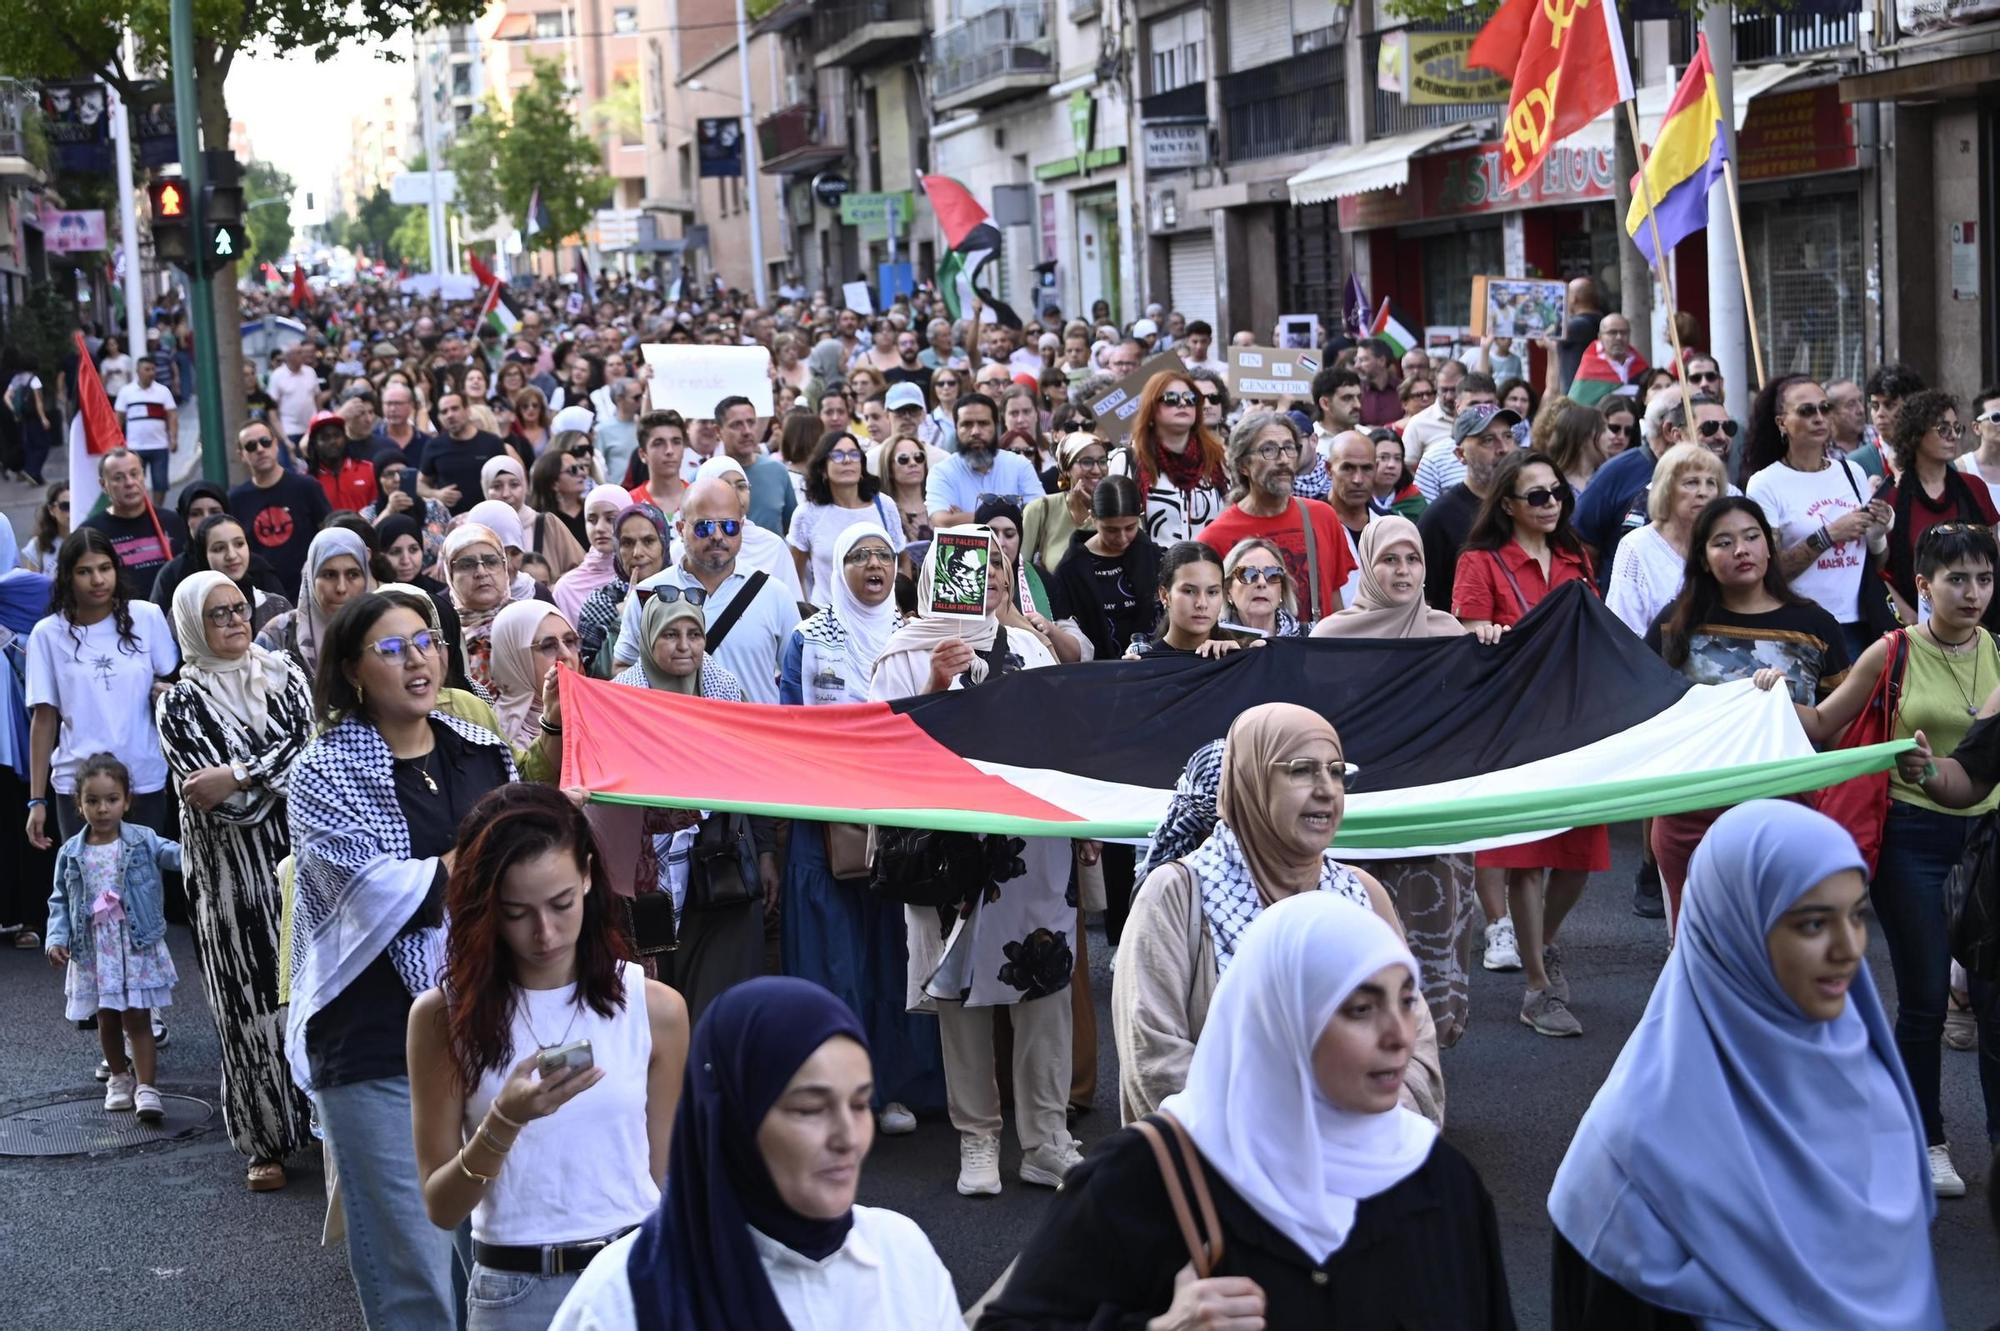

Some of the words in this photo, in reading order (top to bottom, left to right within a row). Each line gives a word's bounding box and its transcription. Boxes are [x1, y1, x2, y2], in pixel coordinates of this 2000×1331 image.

[1153, 127, 1197, 140] SALUD
[1149, 141, 1200, 153] MENTAL
[1241, 355, 1260, 365] FIN
[1276, 365, 1289, 375] AL
[1240, 380, 1308, 393] GENOCIDIO
[1095, 390, 1123, 414] STOP
[257, 505, 294, 536] blur
[938, 536, 954, 545] FREE
[955, 537, 987, 547] PALESTINE
